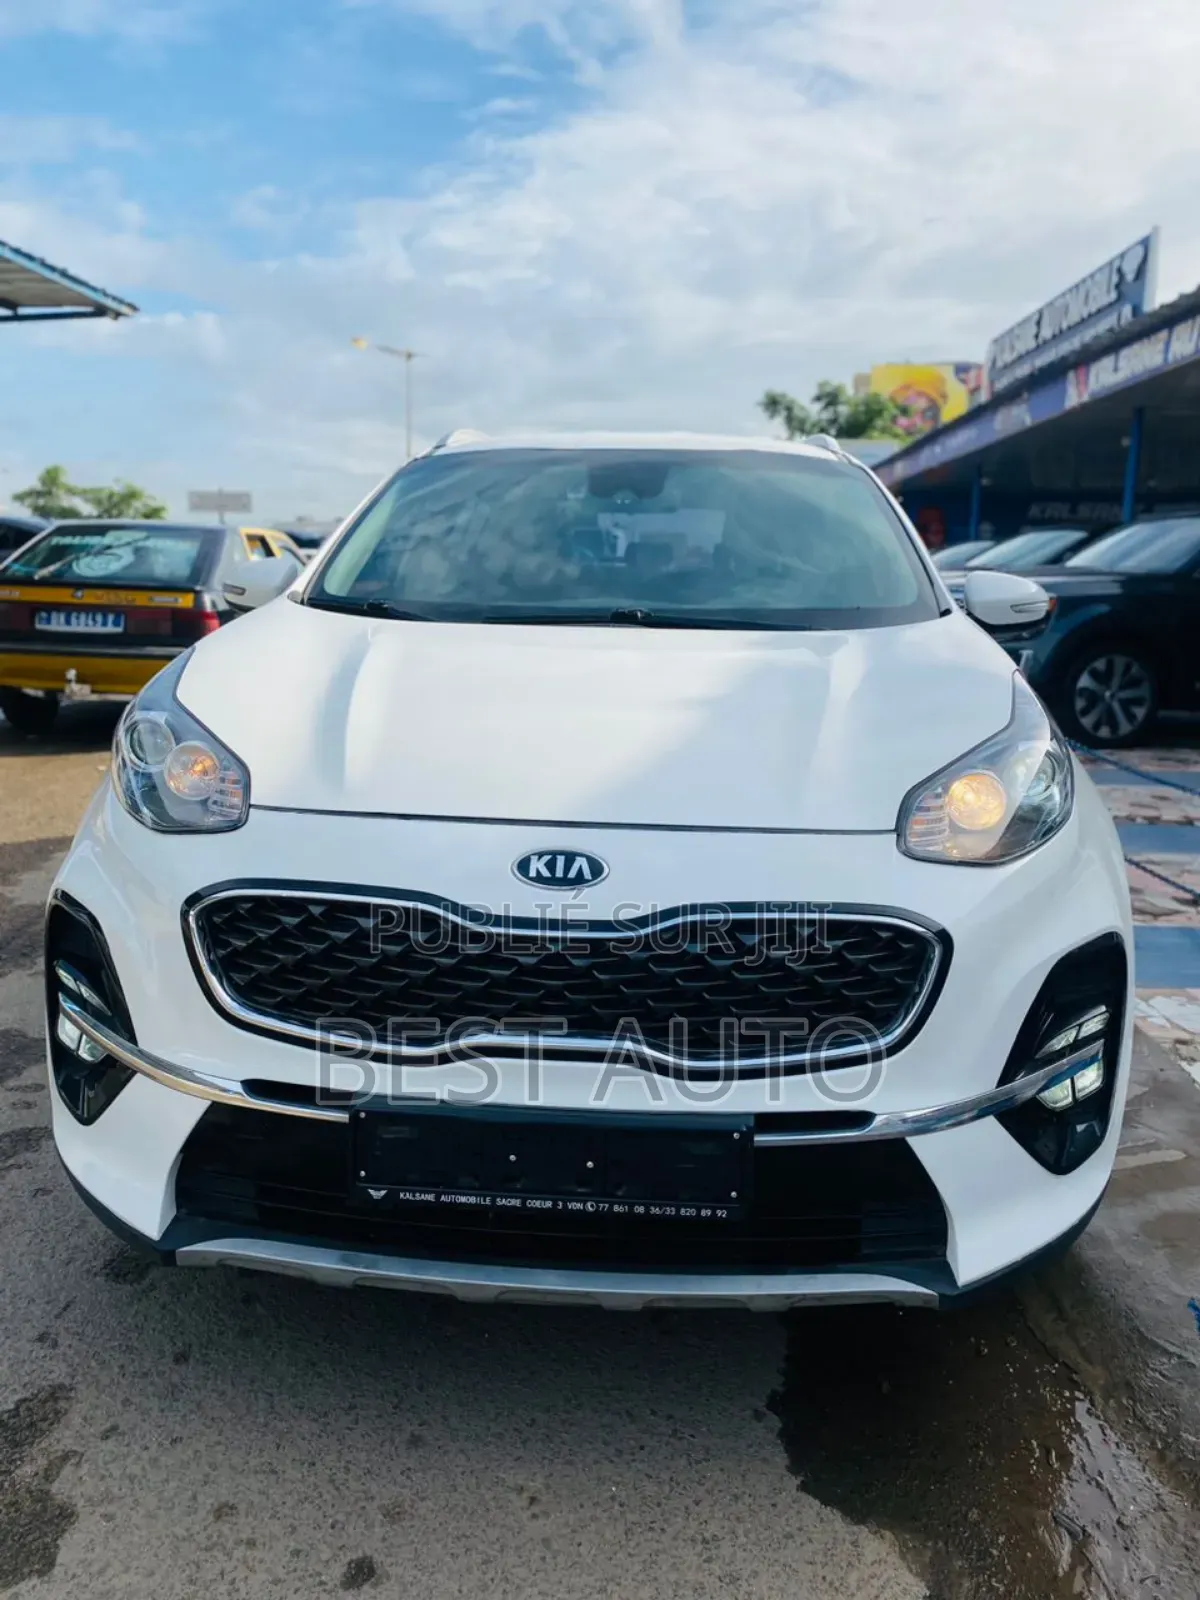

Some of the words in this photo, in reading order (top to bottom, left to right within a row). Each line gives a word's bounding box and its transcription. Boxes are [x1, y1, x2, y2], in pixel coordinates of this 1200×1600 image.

[529, 855, 592, 880] KIA
[399, 1191, 436, 1202] KALSANE
[440, 1194, 492, 1205] AUTOMOBILE
[496, 1197, 522, 1207] SACRE
[526, 1199, 553, 1209] COEUR
[567, 1202, 584, 1211] VDN
[598, 1203, 609, 1212] 77
[613, 1204, 629, 1213] 861
[634, 1205, 645, 1214] 08
[649, 1206, 676, 1216] 36/33
[679, 1208, 697, 1217] 820
[700, 1209, 712, 1218] 89
[716, 1209, 728, 1219] 92
